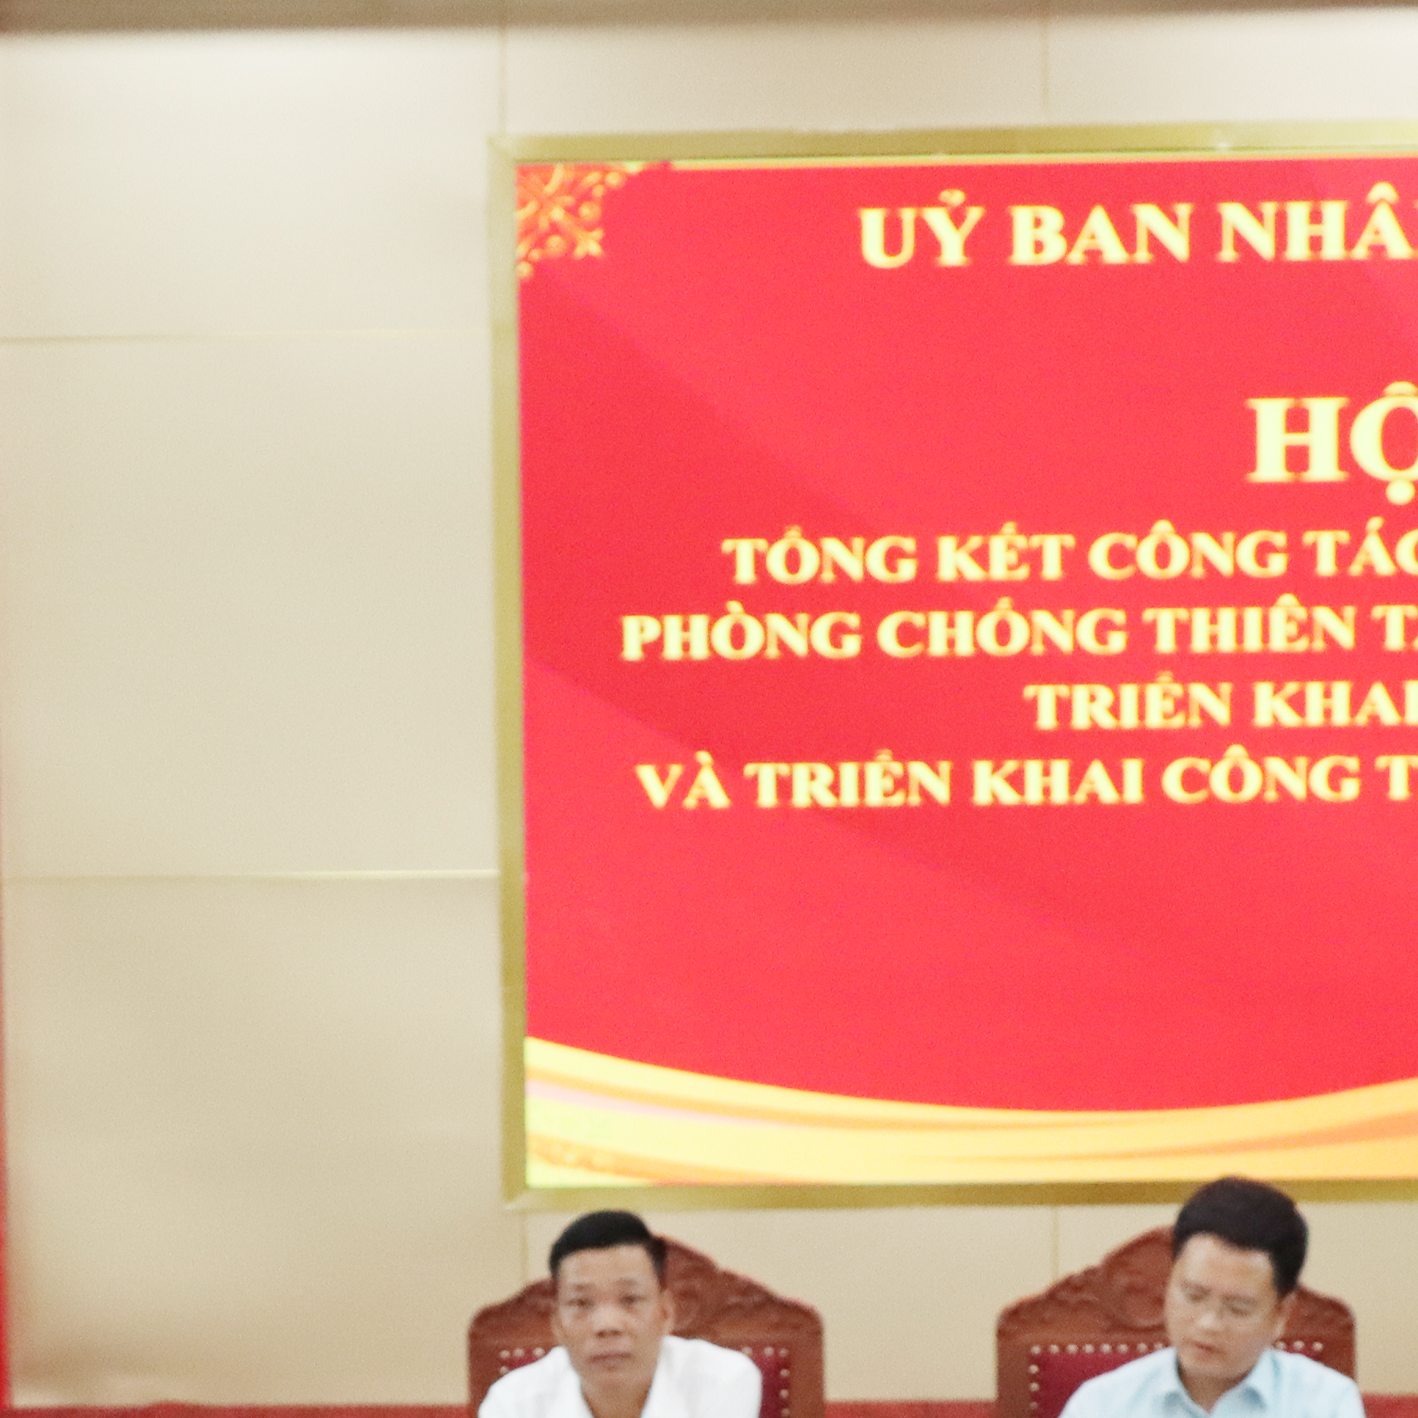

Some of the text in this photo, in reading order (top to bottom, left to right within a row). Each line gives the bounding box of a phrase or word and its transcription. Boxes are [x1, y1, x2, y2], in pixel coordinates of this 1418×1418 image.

[859, 189, 985, 269] UỶ
[1009, 202, 1193, 266] BAN
[936, 521, 1076, 582] KẾT
[1088, 519, 1289, 580] CÔNG
[622, 600, 862, 661] PHÒNG
[876, 597, 1128, 658] CHỐNG
[1142, 593, 1357, 654] THIÊN
[635, 751, 731, 809] VÀ
[972, 758, 1144, 806] KHAI
[1161, 744, 1361, 804] CÔNG
